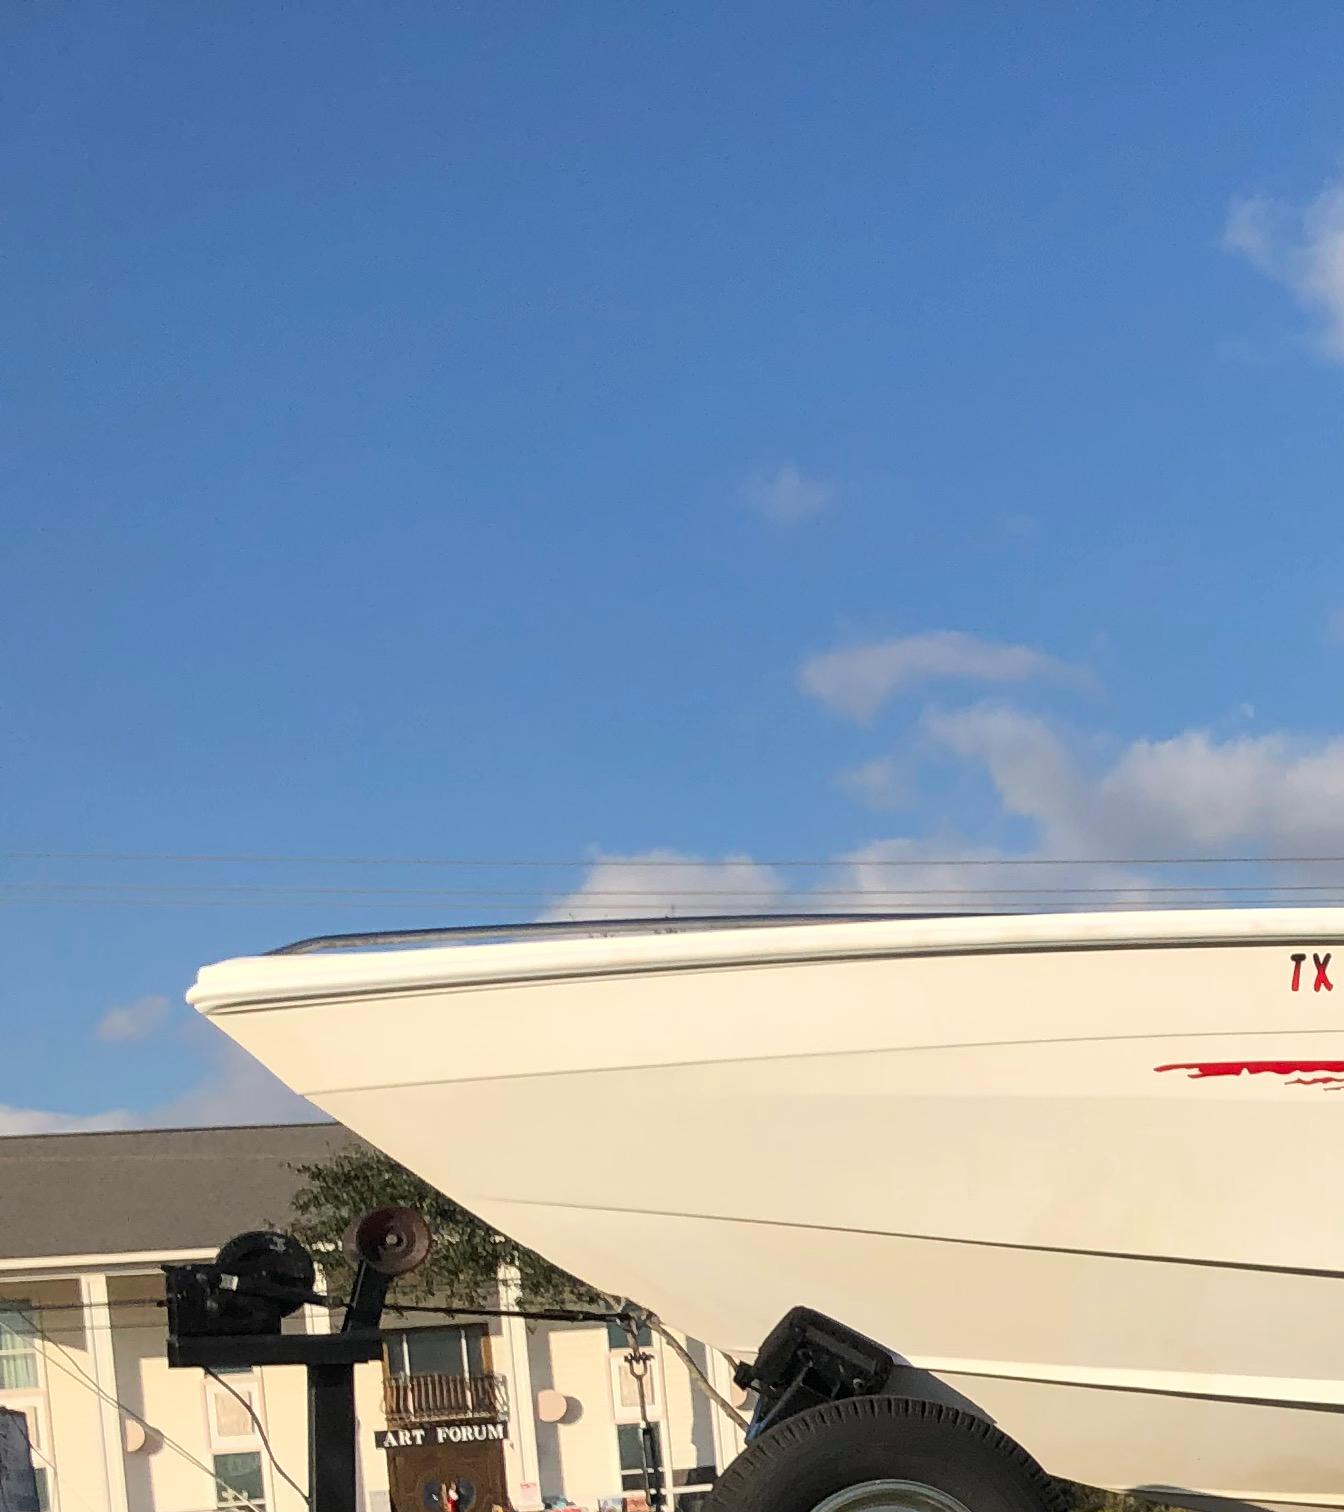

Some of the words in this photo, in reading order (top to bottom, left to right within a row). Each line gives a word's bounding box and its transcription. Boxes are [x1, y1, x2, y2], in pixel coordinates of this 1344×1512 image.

[1290, 952, 1334, 992] TX
[383, 1429, 425, 1447] ART
[437, 1423, 504, 1443] FORUM
